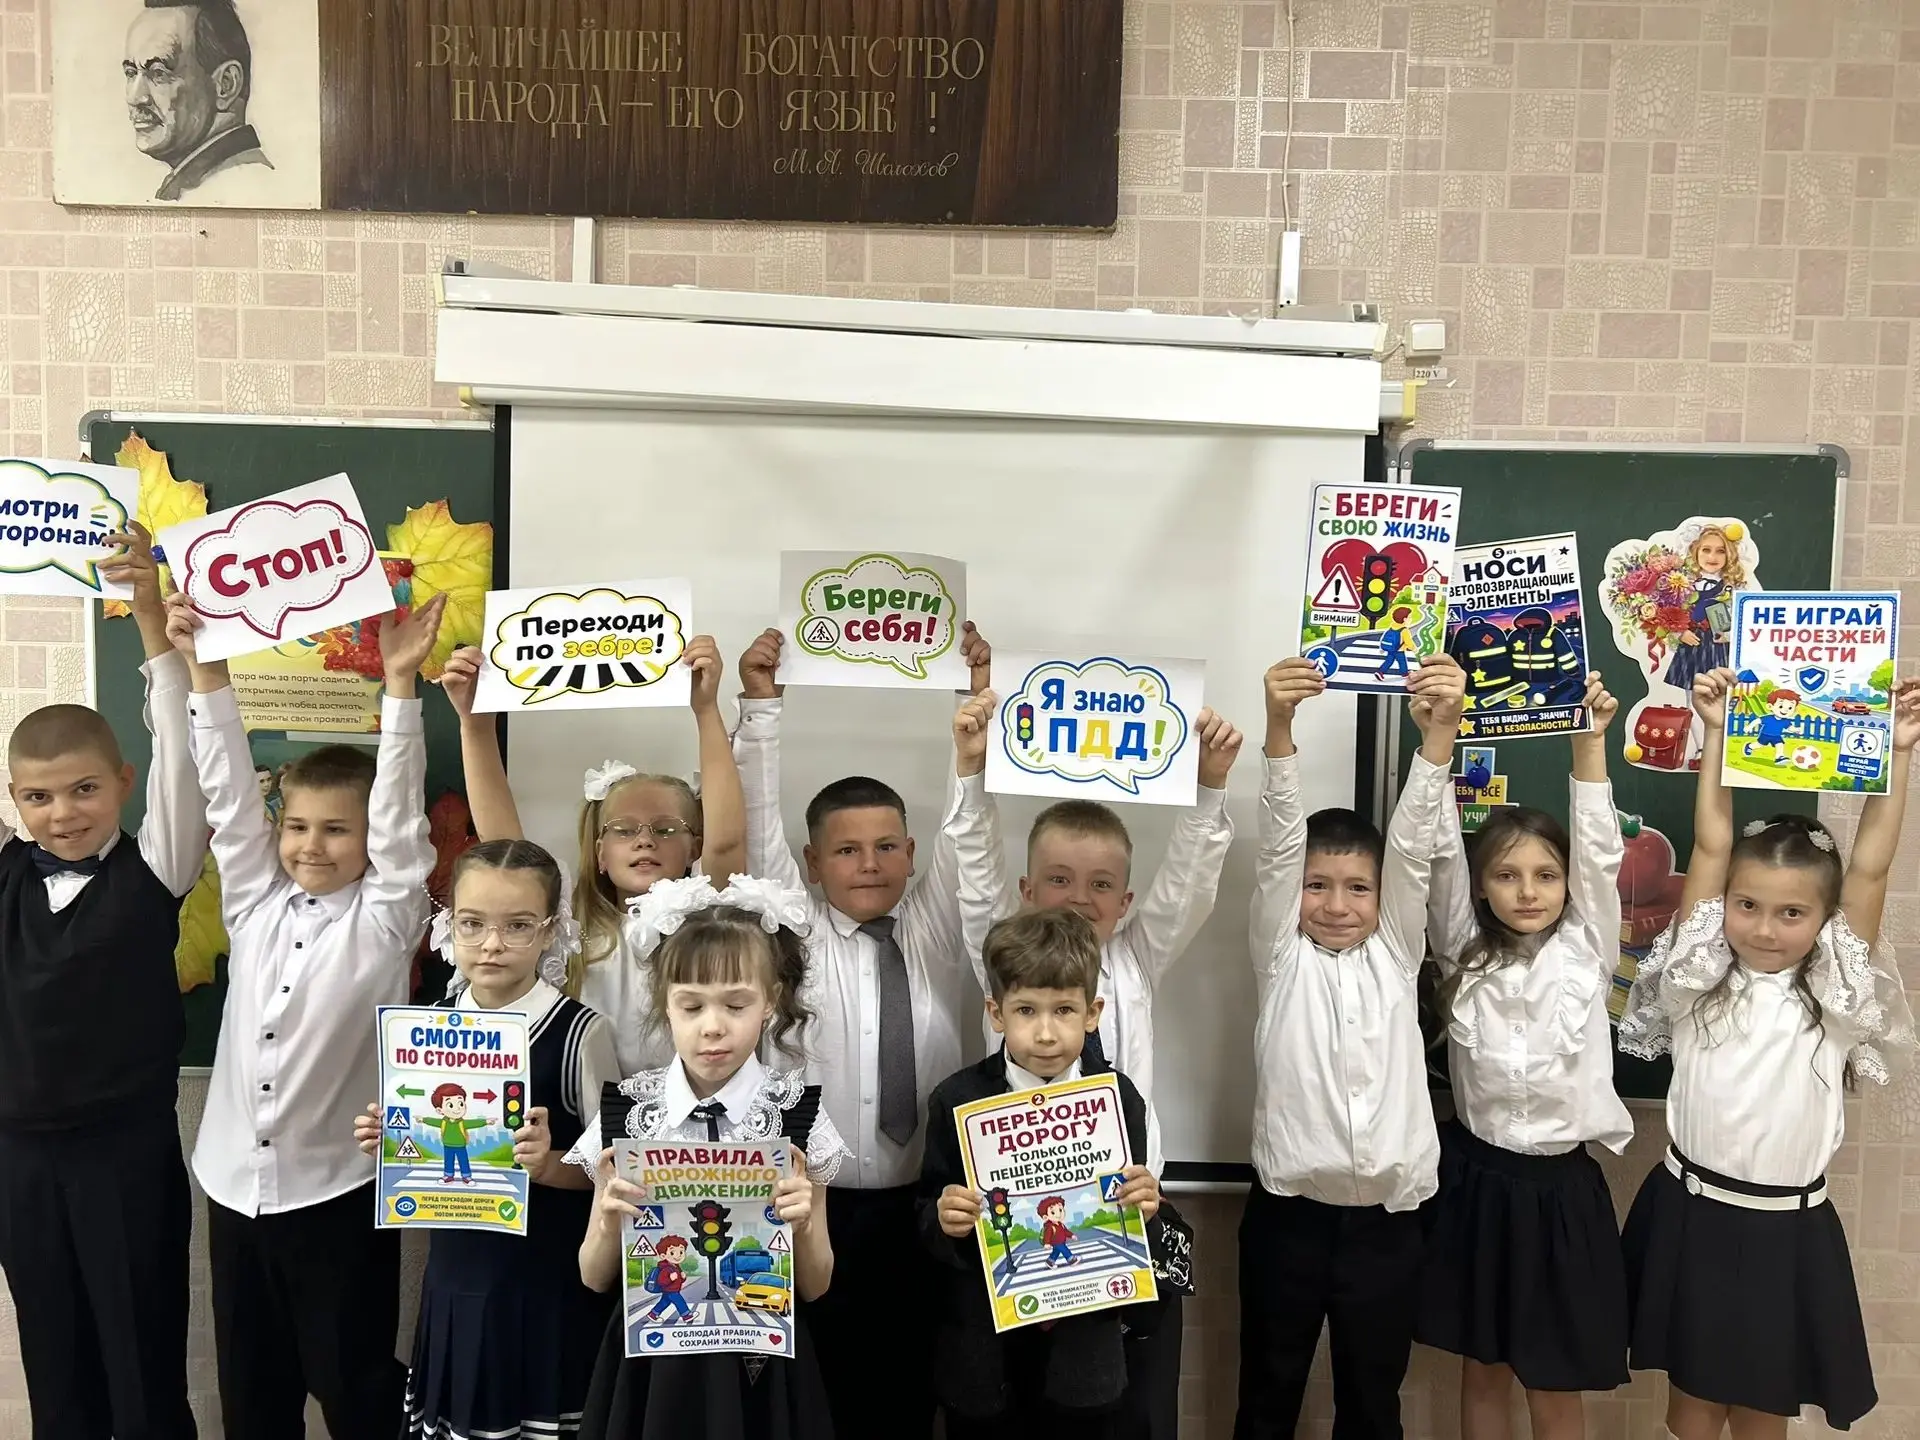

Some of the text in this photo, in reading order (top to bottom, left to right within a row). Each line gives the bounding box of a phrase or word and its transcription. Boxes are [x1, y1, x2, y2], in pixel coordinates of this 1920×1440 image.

[741, 33, 985, 80] БОГАТСТВО
[452, 79, 610, 139] НАРОДА
[666, 86, 744, 129] ЕГО
[779, 89, 897, 133] ЯЗЫК
[773, 149, 812, 174] М.
[1415, 369, 1431, 378] 220
[0, 499, 79, 523] мотри
[1335, 493, 1439, 522] БЕРЕГИ
[1318, 520, 1450, 544] СВОЮ ЖИЗНЬ
[208, 529, 347, 598] Стоп!
[1463, 555, 1546, 582] НОСИ
[1449, 573, 1575, 597] ВЕТОВОЗВРАЩАЮЩИЕ
[823, 584, 941, 617] Береги
[1467, 589, 1550, 610] ЭЛЕМЕНТЫ
[521, 611, 665, 639] Переходи
[1313, 613, 1357, 624] ВНИМАНИЕ
[1753, 604, 1883, 626] НЕ ИГРАЙ
[844, 614, 936, 646] себя!
[1750, 627, 1886, 645] У ПРОЕЗЖЕЙ
[515, 634, 665, 662] по зебре!
[1773, 646, 1856, 663] ЧАСТИ
[233, 673, 256, 682] пора
[258, 674, 277, 682] нам
[291, 675, 318, 685] парты
[320, 676, 360, 684] садиться
[238, 687, 285, 696] открытиям
[287, 689, 314, 697] смело
[1041, 680, 1144, 715] Я знаю
[237, 701, 279, 709] оплощать
[289, 701, 317, 710] побед
[313, 716, 361, 725] проявлять!
[1480, 717, 1500, 725] ТЕБЯ
[1501, 714, 1529, 723] ВИДНО
[1505, 720, 1571, 732] БЕЗОПАСНОСТИ!
[1049, 718, 1166, 759] ПДД!
[1456, 784, 1501, 798] ЕБЯ ВСЁ
[410, 1026, 501, 1050] СМОТРИ
[396, 1048, 518, 1069] ПО СТОРОНАМ
[980, 1097, 1107, 1136] ПЕРЕХОДИ
[997, 1118, 1098, 1155] ДОРОГУ
[645, 1149, 764, 1166] ПРАВИЛА
[1011, 1140, 1092, 1164] ТОЛЬКО ПО
[642, 1168, 777, 1185] ДОРОЖНОГО
[990, 1149, 1112, 1182] ПЕШЕХОДНОМУ
[1015, 1167, 1095, 1191] ПЕРЕХОДУ
[654, 1184, 773, 1200] ДВИЖЕНИЯ
[672, 1329, 720, 1338] СОБЛЮДАЙ
[723, 1329, 762, 1337] ПРАВИЛА
[679, 1338, 755, 1347] СОХРАНИ ЖИЗНЬ!
